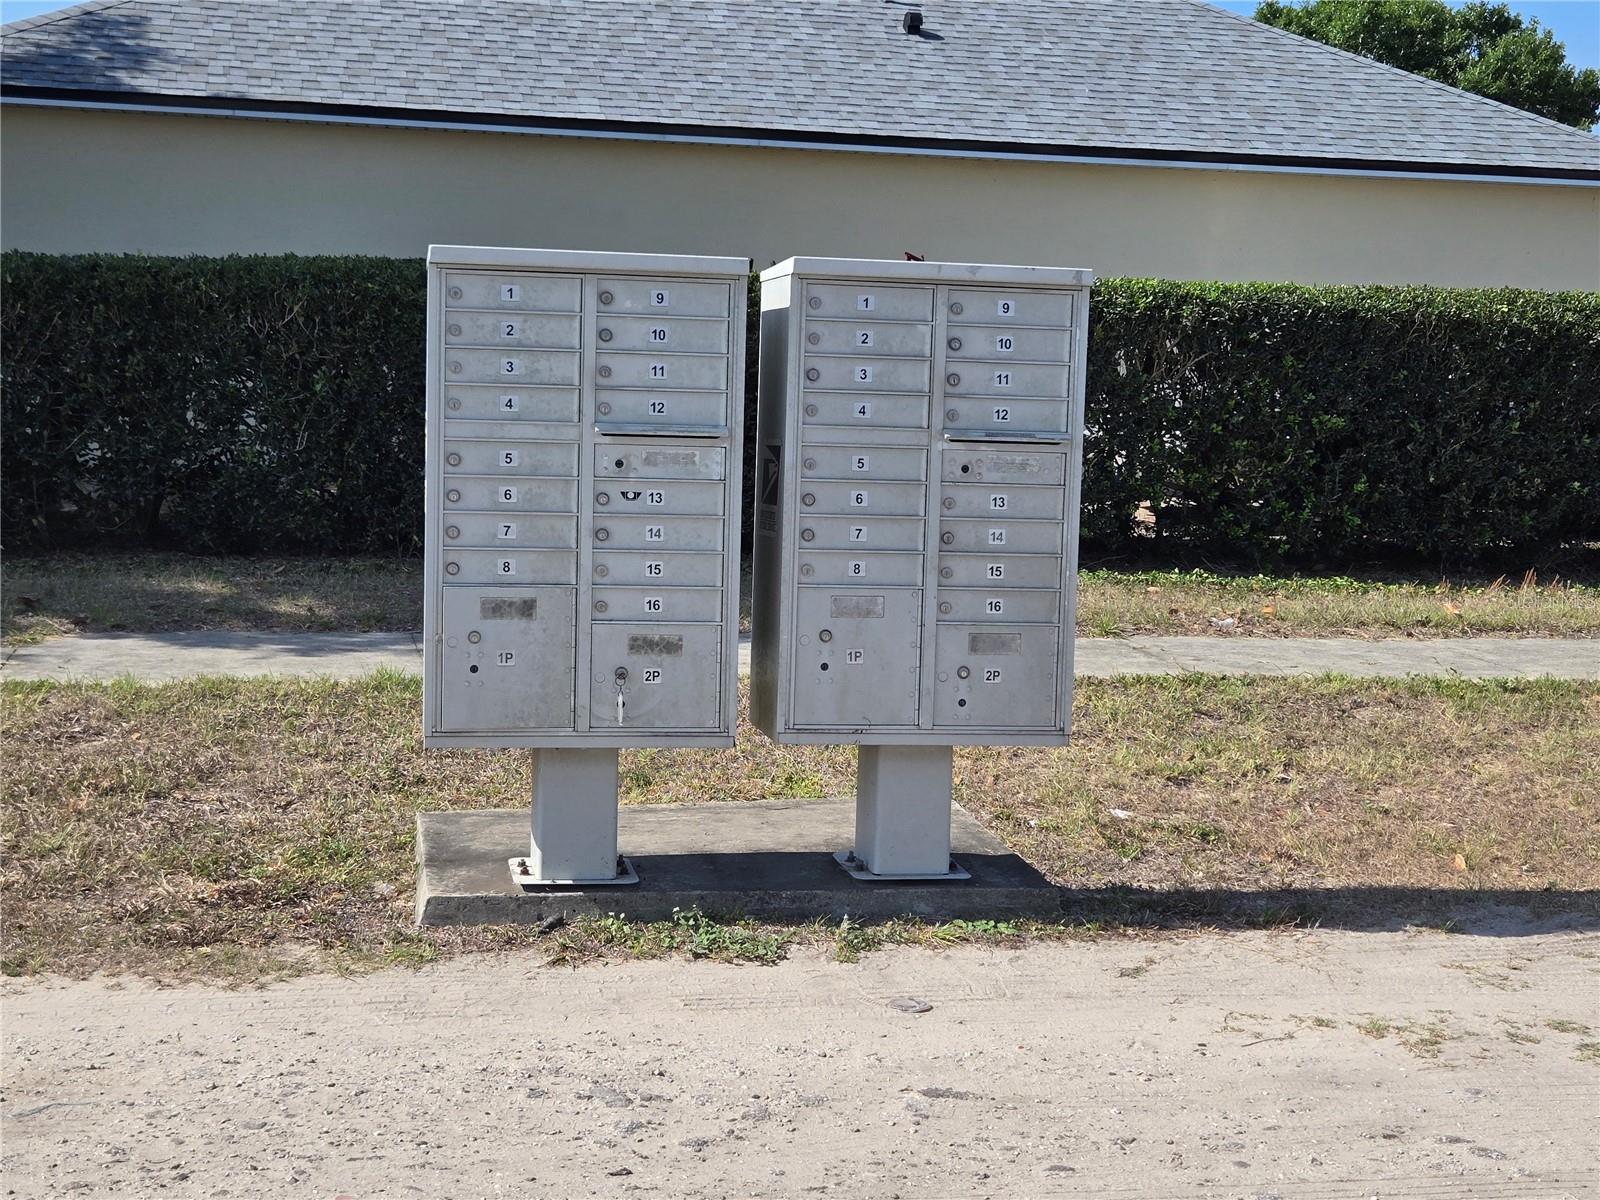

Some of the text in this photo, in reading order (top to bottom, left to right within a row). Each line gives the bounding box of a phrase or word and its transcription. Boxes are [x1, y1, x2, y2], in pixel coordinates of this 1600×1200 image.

[506, 287, 513, 300] 1
[656, 292, 665, 305] 9
[863, 297, 869, 309] 1
[1002, 302, 1010, 314] 9
[505, 324, 514, 337] 2
[651, 328, 666, 341] 10
[860, 332, 869, 345] 2
[998, 338, 1012, 350] 10
[505, 360, 514, 373] 3
[651, 365, 665, 377] 11
[859, 368, 868, 381] 3
[996, 373, 1009, 385] 11
[504, 397, 514, 410] 4
[650, 401, 665, 414] 12
[858, 405, 866, 417] 4
[994, 408, 1009, 421] 12
[504, 452, 513, 465] 5
[856, 457, 865, 470] 5
[503, 488, 512, 501] 6
[648, 491, 663, 504] 13
[855, 493, 864, 505] 6
[991, 496, 1006, 508] 13
[503, 525, 512, 537] 7
[647, 527, 662, 539] 14
[855, 528, 863, 540] 7
[990, 531, 1004, 543] 14
[502, 561, 511, 573] 8
[646, 563, 662, 576] 15
[853, 563, 861, 575] 8
[988, 565, 1002, 577] 15
[646, 599, 661, 611] 16
[987, 600, 1002, 612] 16
[498, 652, 514, 664] 1P
[847, 650, 863, 663] 1P
[644, 670, 661, 682] 2P
[985, 670, 1001, 682] 2P
